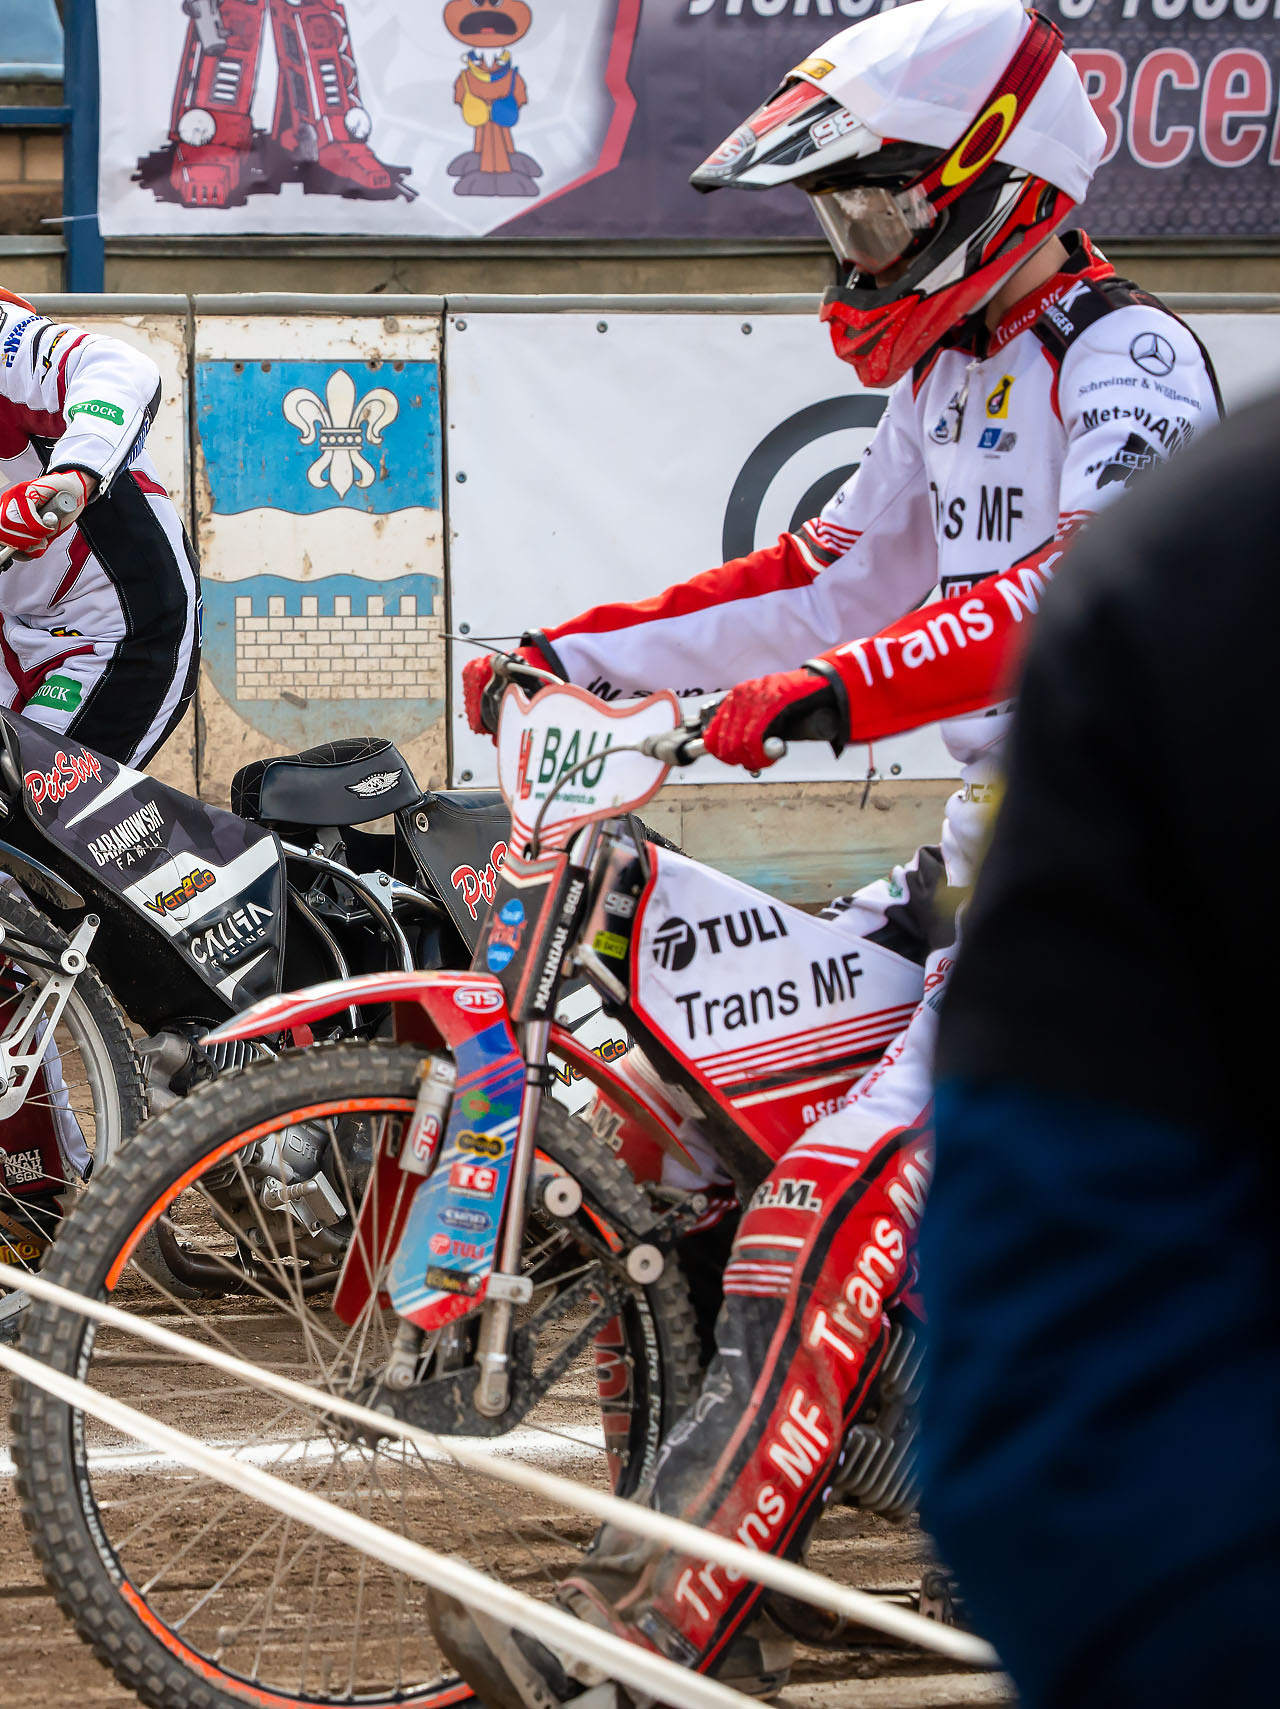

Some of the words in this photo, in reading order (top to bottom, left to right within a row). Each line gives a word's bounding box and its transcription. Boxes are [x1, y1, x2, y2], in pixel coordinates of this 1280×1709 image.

[1141, 378, 1150, 389] &
[977, 485, 1024, 543] MF
[836, 594, 995, 687] Trans
[538, 726, 612, 789] BAU
[116, 831, 163, 871] FAMILY
[210, 928, 267, 969] RACING
[698, 904, 788, 952] TULI
[458, 990, 498, 1006] STS
[675, 976, 800, 1042] Trans
[811, 951, 865, 1008] MF
[413, 1114, 439, 1162] STS
[457, 1166, 494, 1191] TC
[452, 1240, 486, 1260] TULI
[808, 1217, 906, 1362] Trans
[767, 1388, 831, 1489] MF
